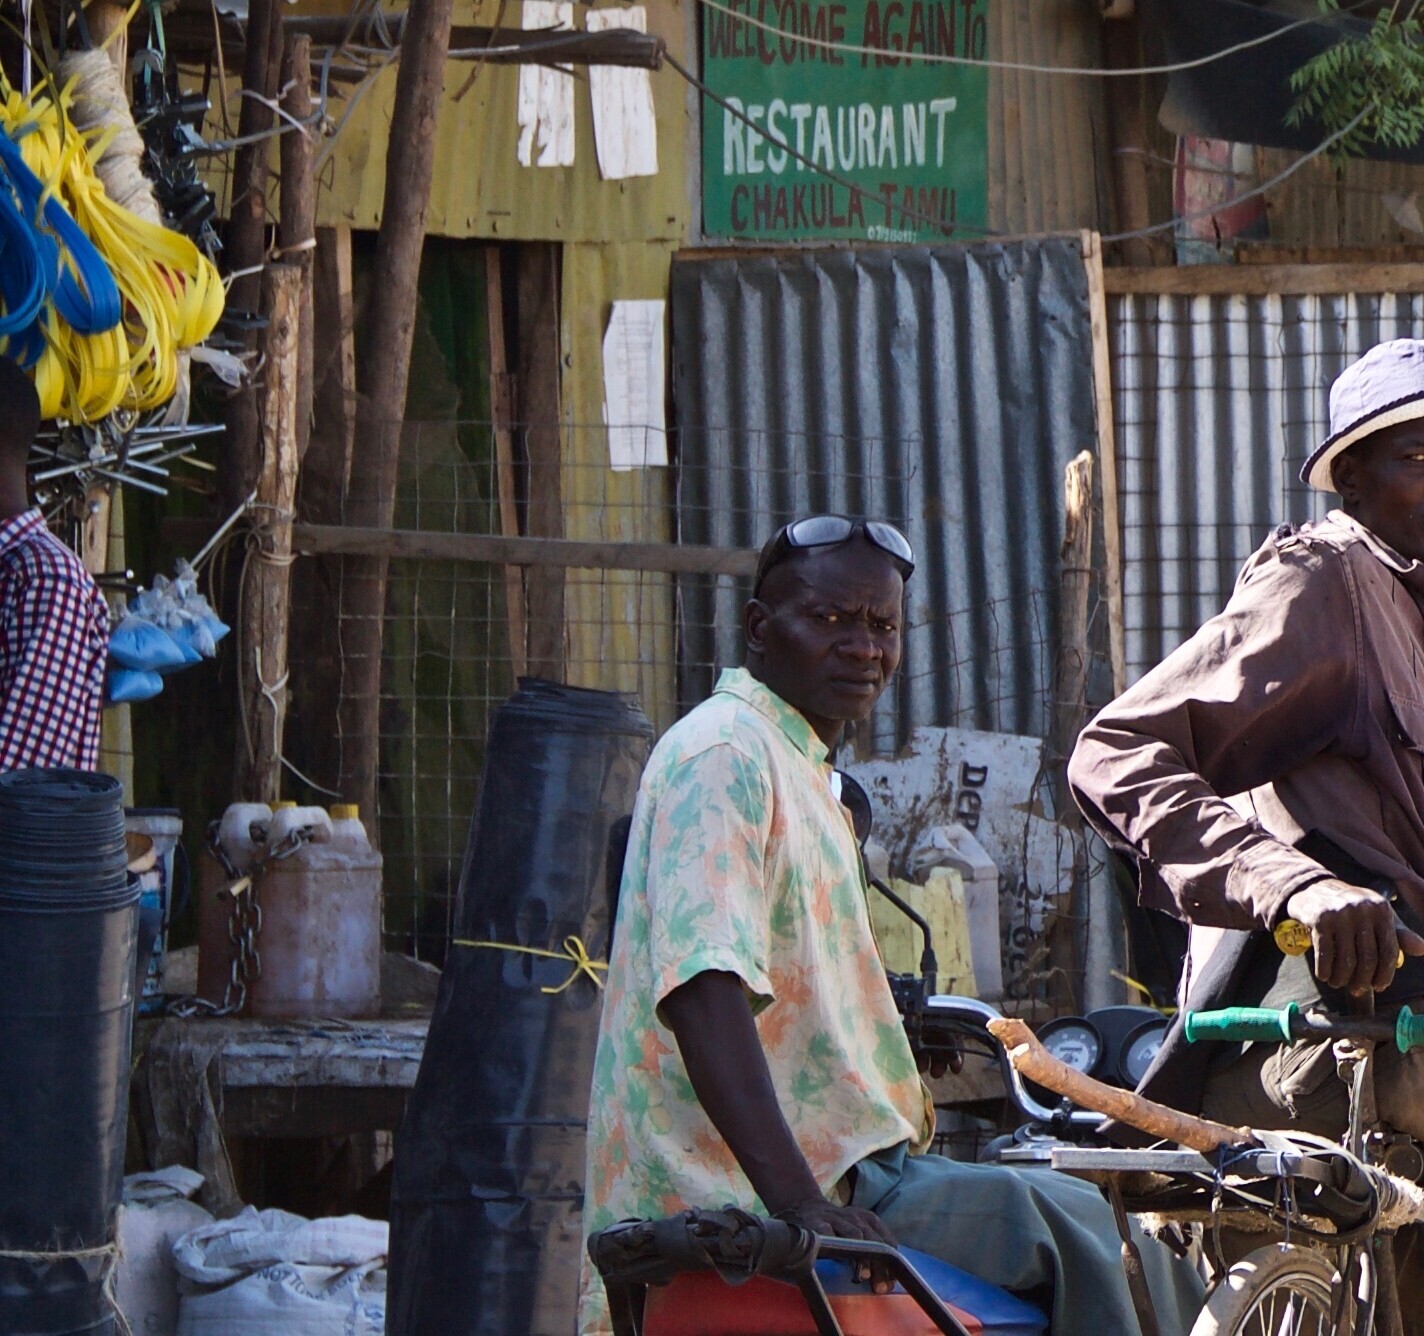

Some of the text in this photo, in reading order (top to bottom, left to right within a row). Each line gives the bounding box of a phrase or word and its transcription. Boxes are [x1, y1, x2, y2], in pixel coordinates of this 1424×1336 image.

[706, 0, 847, 66] WELCOME
[860, 0, 956, 68] AGAIN
[723, 97, 957, 176] RESTAURANT
[730, 182, 956, 238] CHAKULA TAMU
